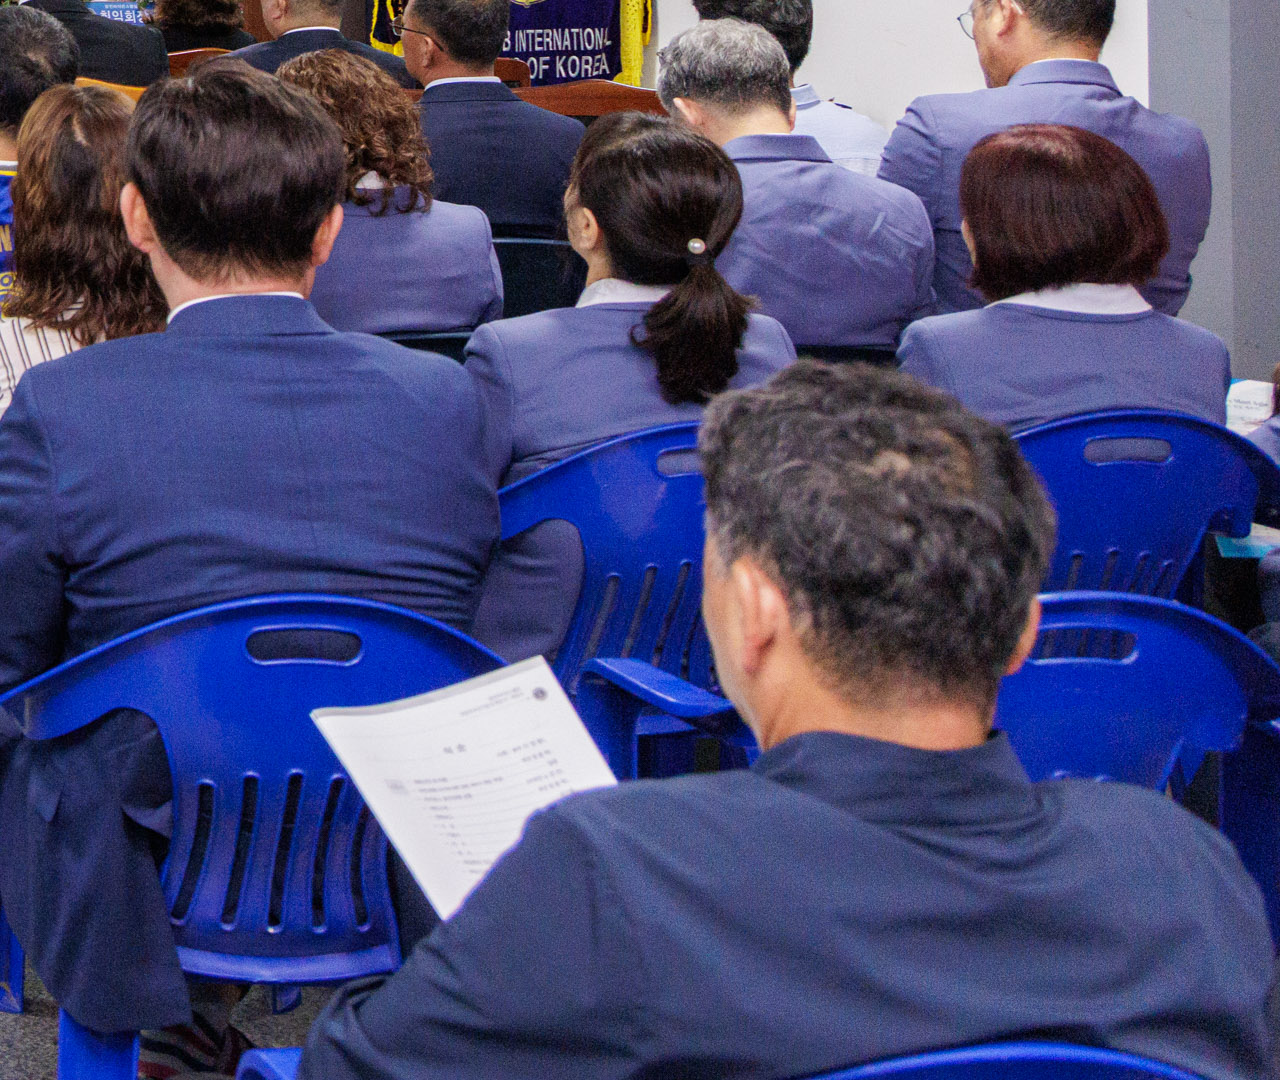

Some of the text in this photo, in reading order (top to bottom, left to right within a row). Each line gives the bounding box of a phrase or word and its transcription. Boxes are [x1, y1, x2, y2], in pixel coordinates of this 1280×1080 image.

[515, 27, 612, 52] INTERNATIONL
[527, 52, 611, 79] OF KOREA
